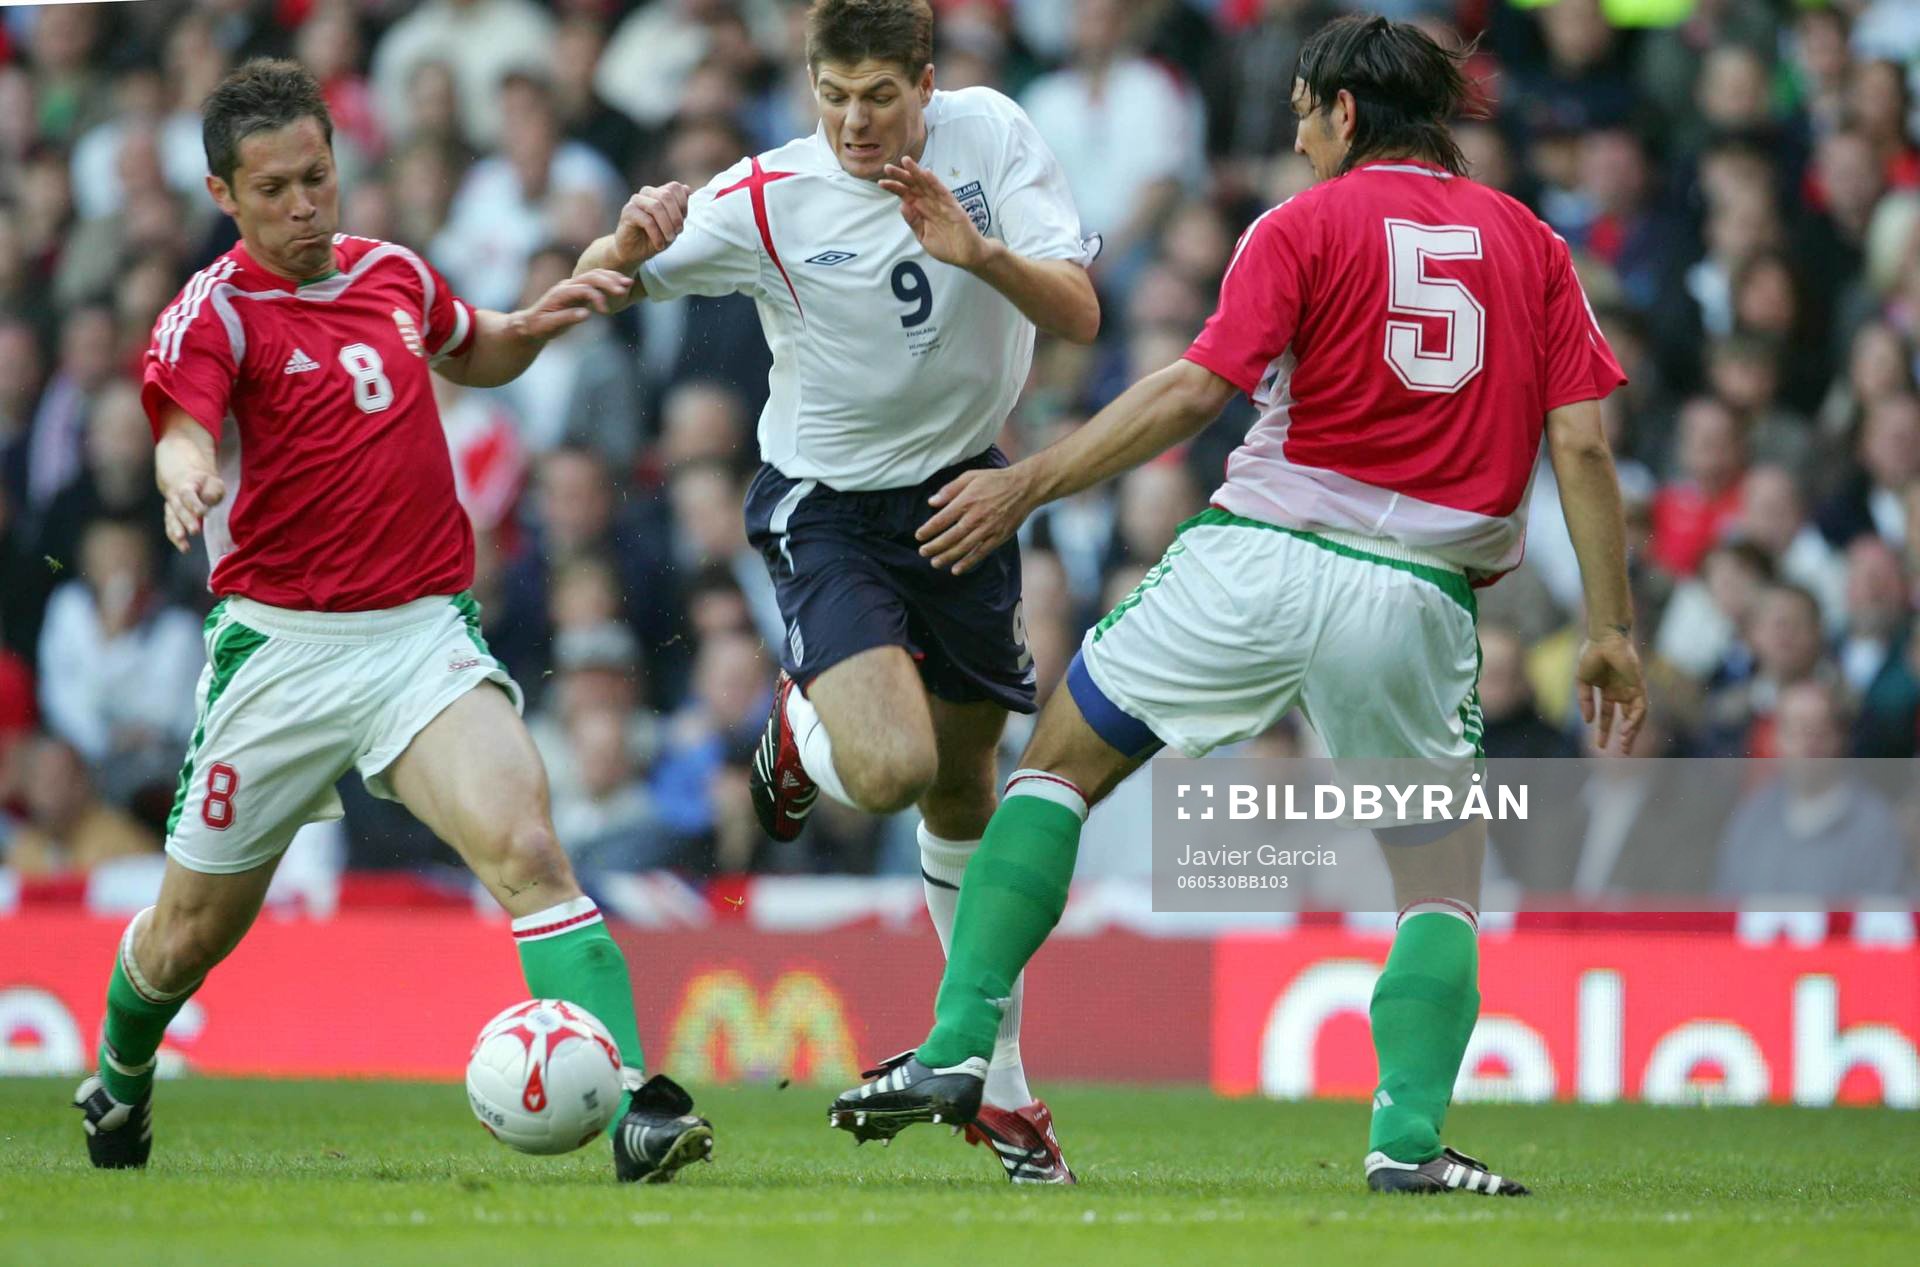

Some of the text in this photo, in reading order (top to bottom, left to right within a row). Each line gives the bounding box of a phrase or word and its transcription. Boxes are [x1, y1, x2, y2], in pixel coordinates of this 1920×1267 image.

[953, 182, 980, 198] GLAND
[890, 260, 933, 328] 9
[1383, 216, 1486, 394] 5
[338, 342, 394, 414] 8
[202, 760, 240, 831] 8
